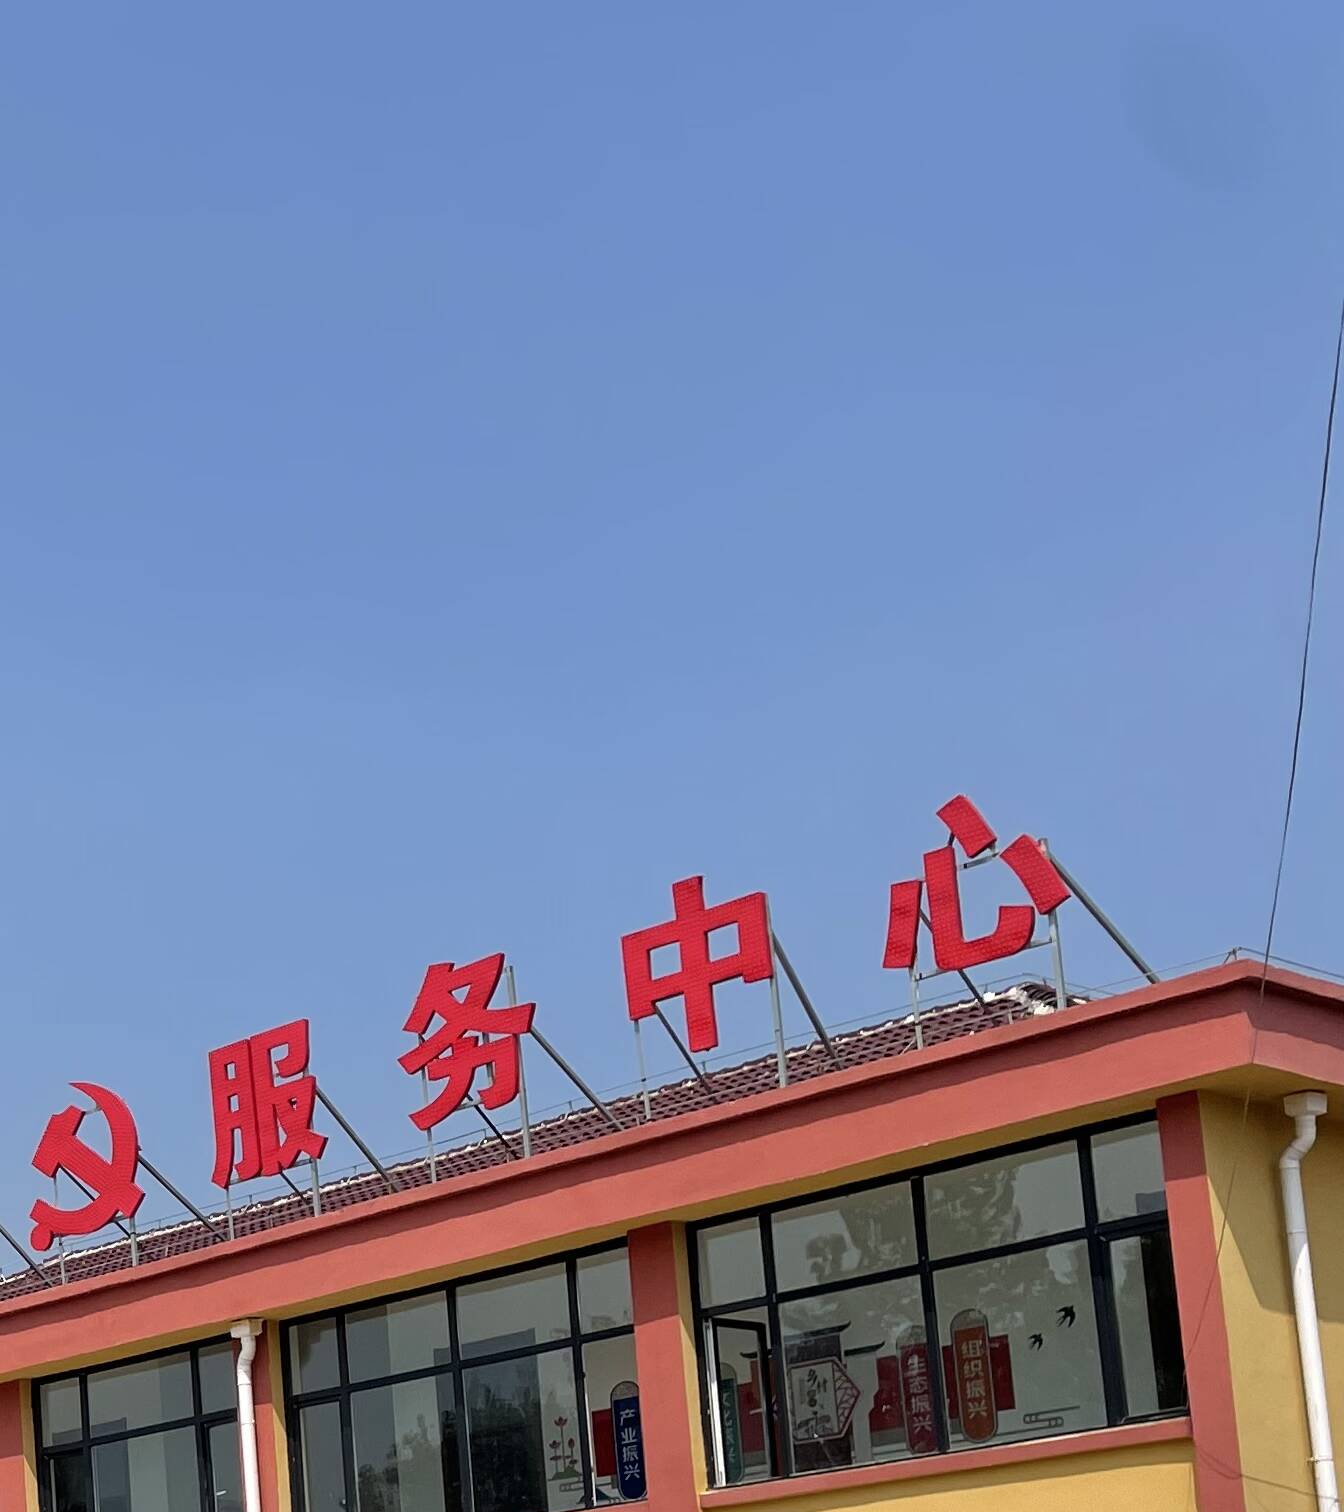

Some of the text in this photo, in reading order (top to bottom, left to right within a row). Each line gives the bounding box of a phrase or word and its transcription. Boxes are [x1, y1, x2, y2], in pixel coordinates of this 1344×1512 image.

[210, 794, 1072, 1188] 服务中心
[904, 1354, 933, 1434] 生态振兴
[962, 1339, 988, 1420] 组织振兴
[619, 1408, 640, 1480] 产业振兴
